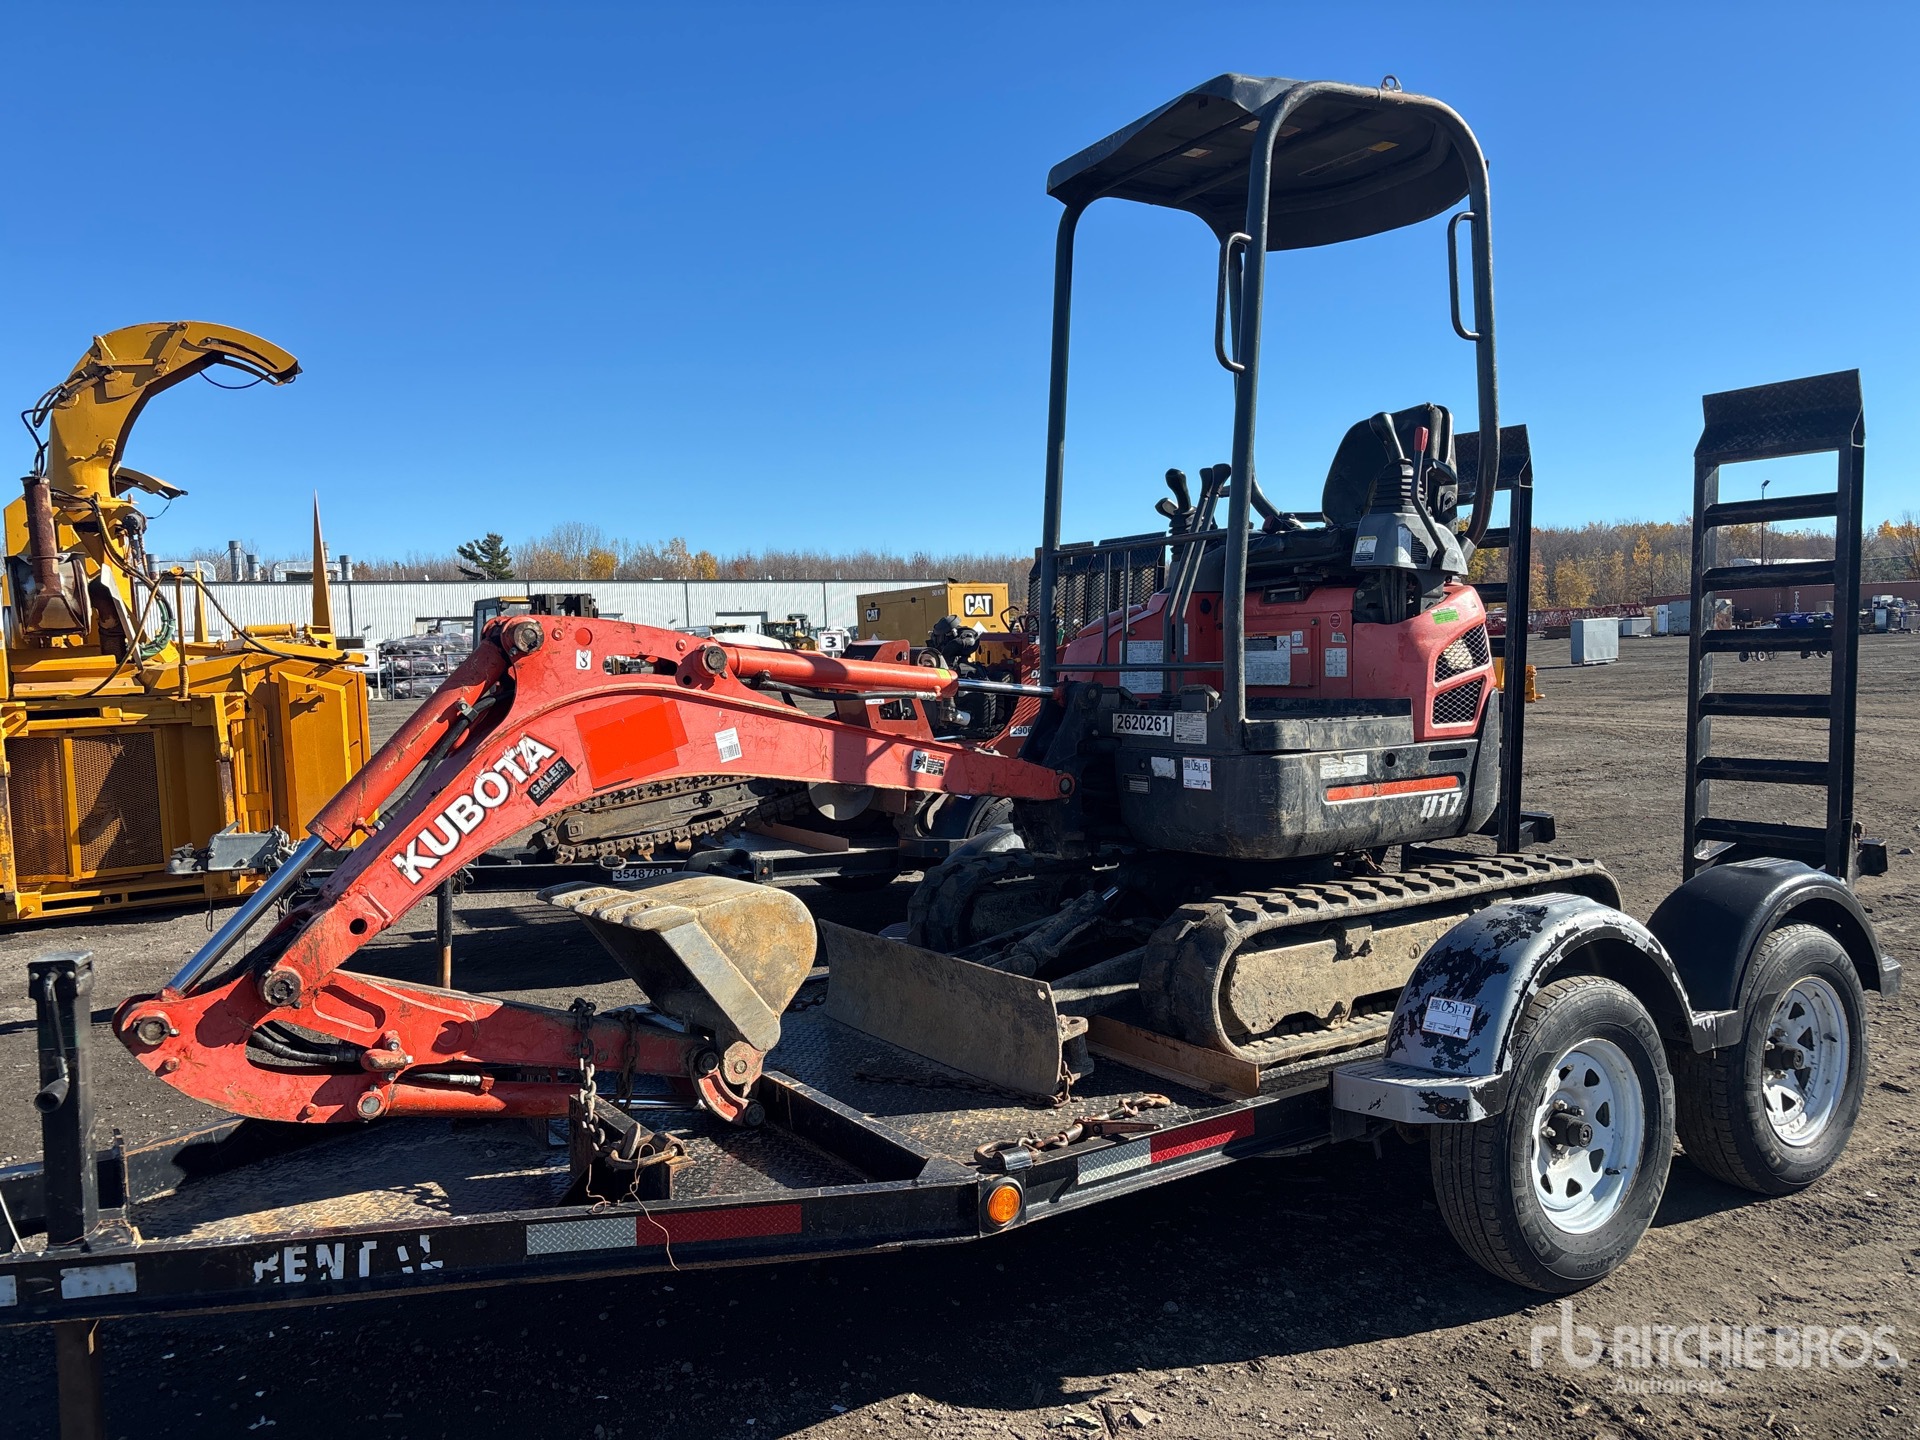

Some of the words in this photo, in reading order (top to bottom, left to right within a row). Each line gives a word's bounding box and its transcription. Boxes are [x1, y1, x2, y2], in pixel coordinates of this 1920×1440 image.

[965, 595, 991, 615] CAT
[866, 609, 878, 621] CAT
[825, 636, 837, 648] 3
[1117, 714, 1168, 732] 2620261
[530, 761, 565, 794] GALER
[391, 735, 556, 885] KUBOTA
[1420, 791, 1462, 818] U17
[1441, 1001, 1471, 1015] 051-17
